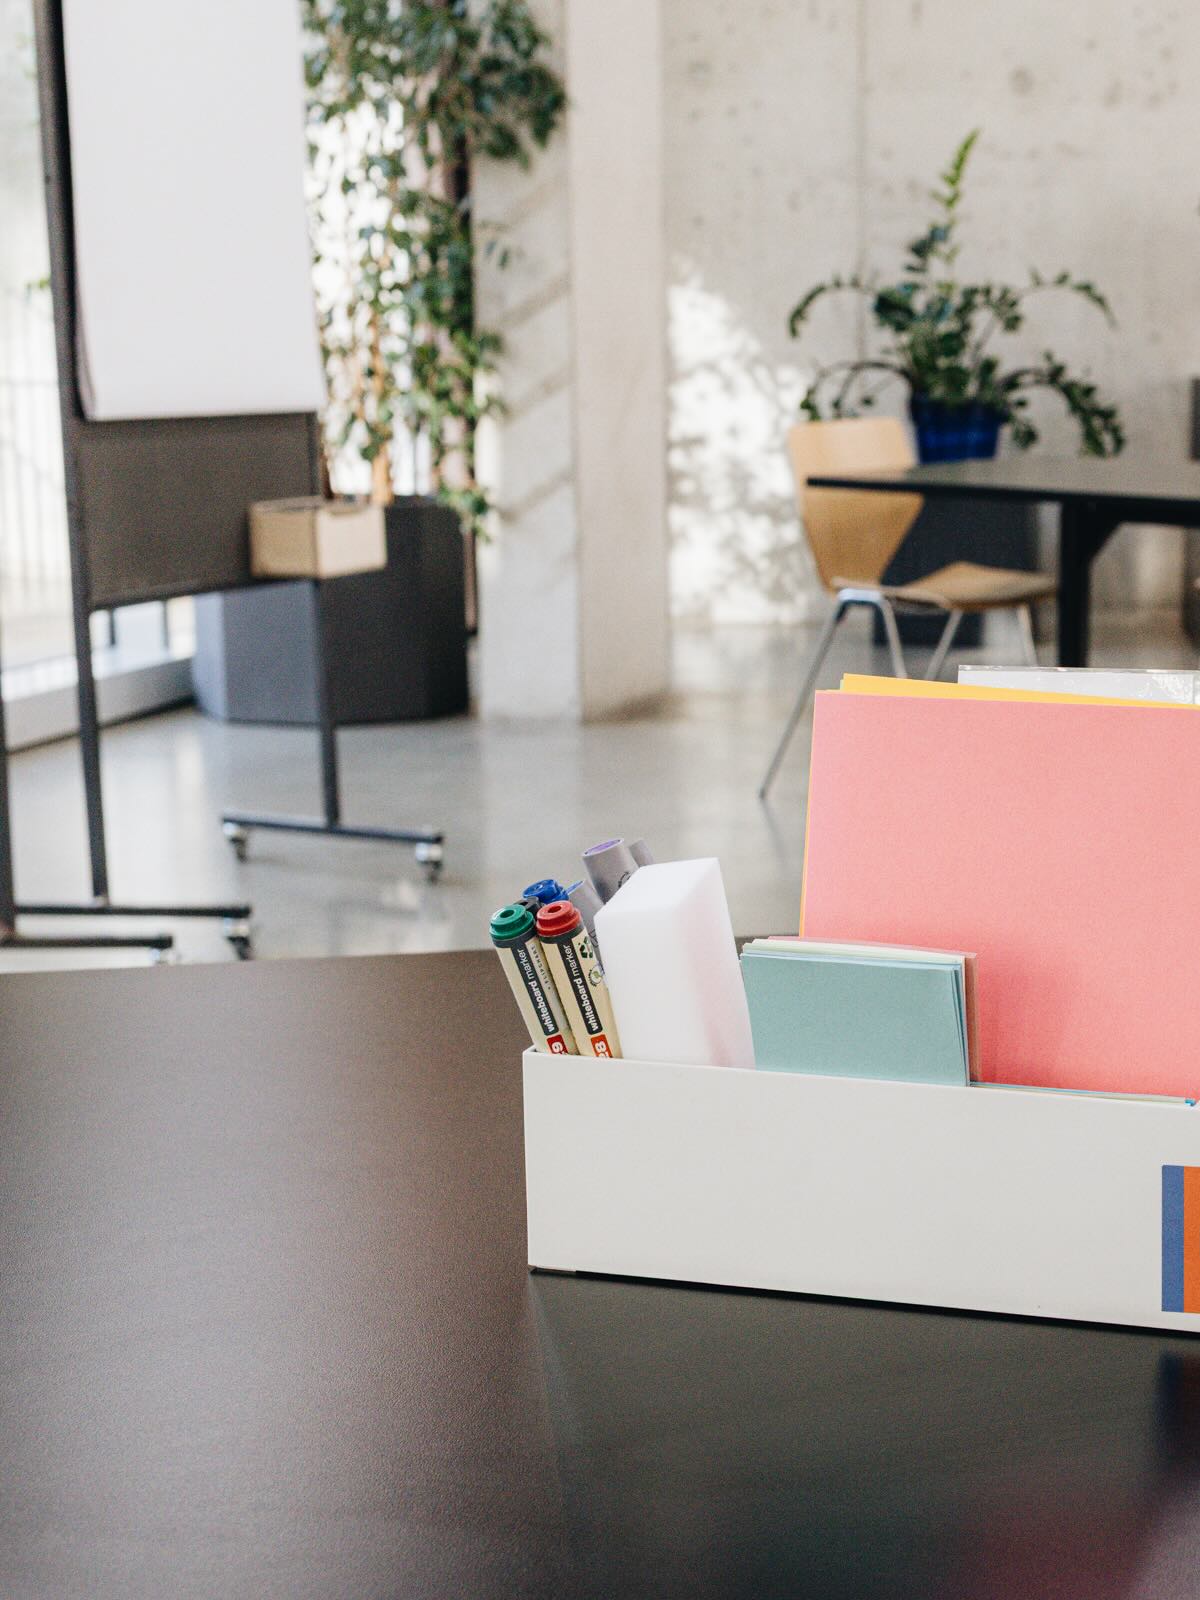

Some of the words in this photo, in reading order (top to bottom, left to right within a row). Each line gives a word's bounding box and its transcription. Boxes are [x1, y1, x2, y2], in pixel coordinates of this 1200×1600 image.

[516, 948, 535, 980] marker
[563, 944, 580, 977] marker
[528, 980, 555, 1033] whiteboard
[574, 977, 599, 1032] whiteboard
